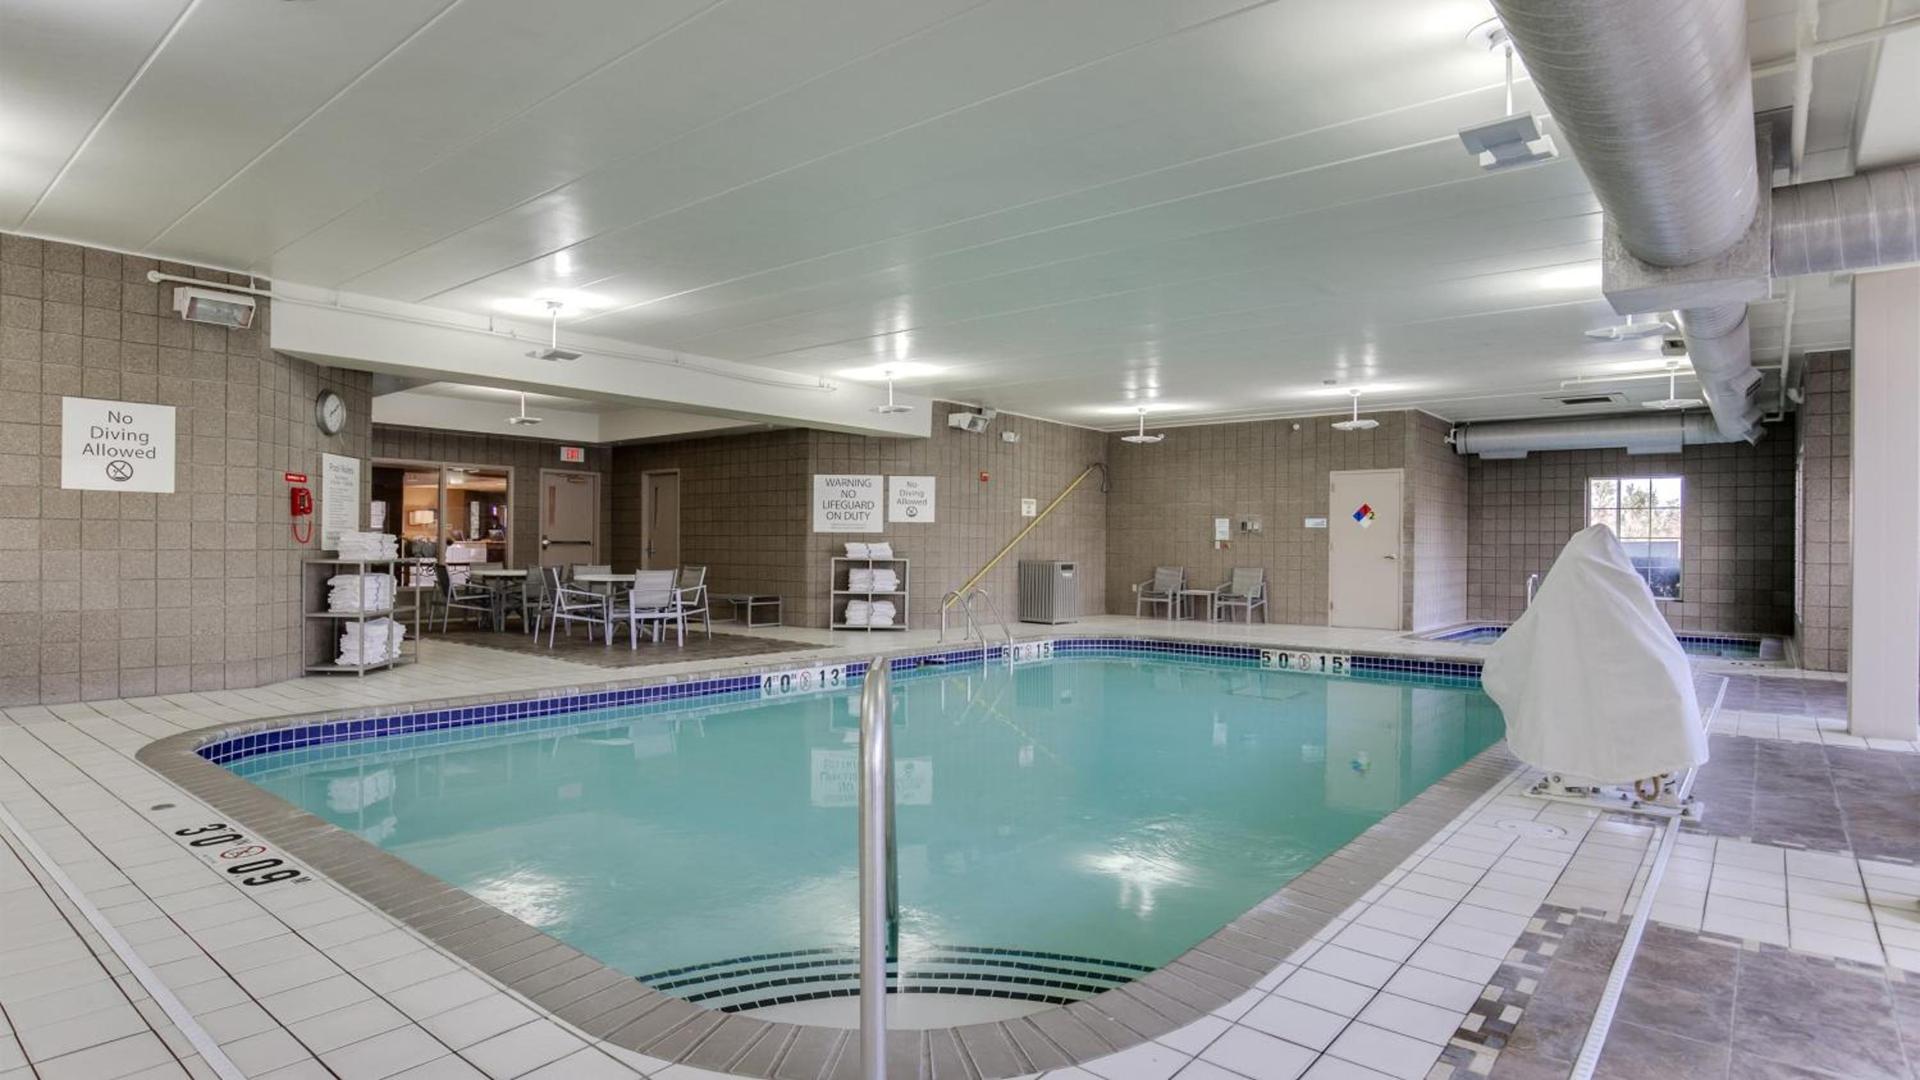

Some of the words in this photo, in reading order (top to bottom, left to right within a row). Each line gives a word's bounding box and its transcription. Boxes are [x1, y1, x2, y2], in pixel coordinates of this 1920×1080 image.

[107, 410, 133, 425] No
[90, 425, 149, 446] Diving
[82, 442, 156, 459] Allowed
[825, 478, 872, 488] WARNING
[841, 489, 856, 499] NO
[899, 489, 925, 498] Diving
[822, 500, 875, 510] LIFEGUARD
[826, 511, 841, 521] ON
[844, 511, 871, 521] DUTY
[1368, 511, 1376, 520] 2
